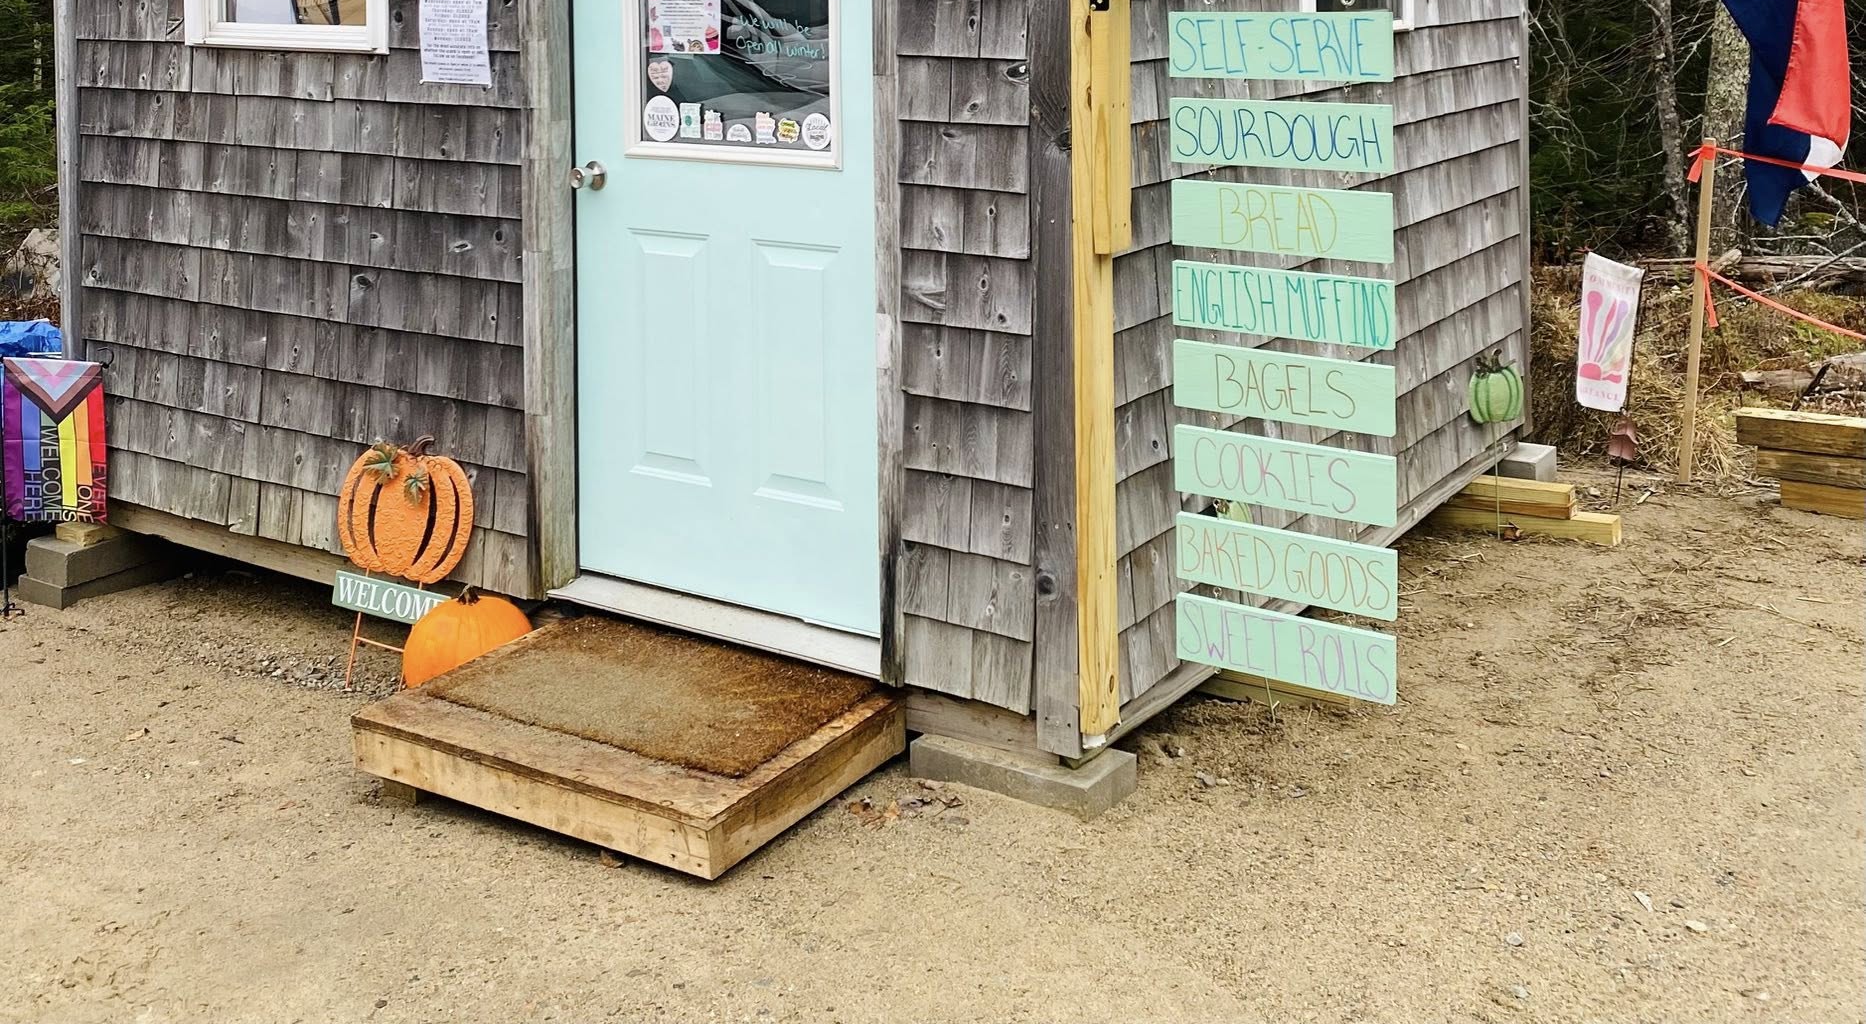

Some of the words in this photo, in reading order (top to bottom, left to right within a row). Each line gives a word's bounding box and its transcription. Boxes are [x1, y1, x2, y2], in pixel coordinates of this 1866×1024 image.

[735, 35, 764, 55] Open
[766, 39, 782, 54] all
[786, 42, 826, 60] winter!
[739, 13, 760, 27] We
[762, 18, 789, 30] will
[795, 19, 812, 36] be
[1175, 105, 1383, 168] SOURDOUGH
[1219, 187, 1338, 254] BREAD
[1176, 266, 1277, 335] ENGLISH
[1285, 275, 1390, 347] MUFFINS
[1215, 353, 1356, 419] BAGELS
[24, 470, 44, 522] HERE
[41, 426, 63, 522] WELCOME
[77, 484, 94, 524] ONE
[92, 463, 108, 525] EVERY
[1193, 436, 1356, 514] COOKIES
[62, 506, 77, 522] IS
[1181, 524, 1276, 590] BAKED
[1284, 541, 1391, 611] GOODS
[1181, 599, 1284, 675] SWEET
[1299, 624, 1390, 700] ROLLS
